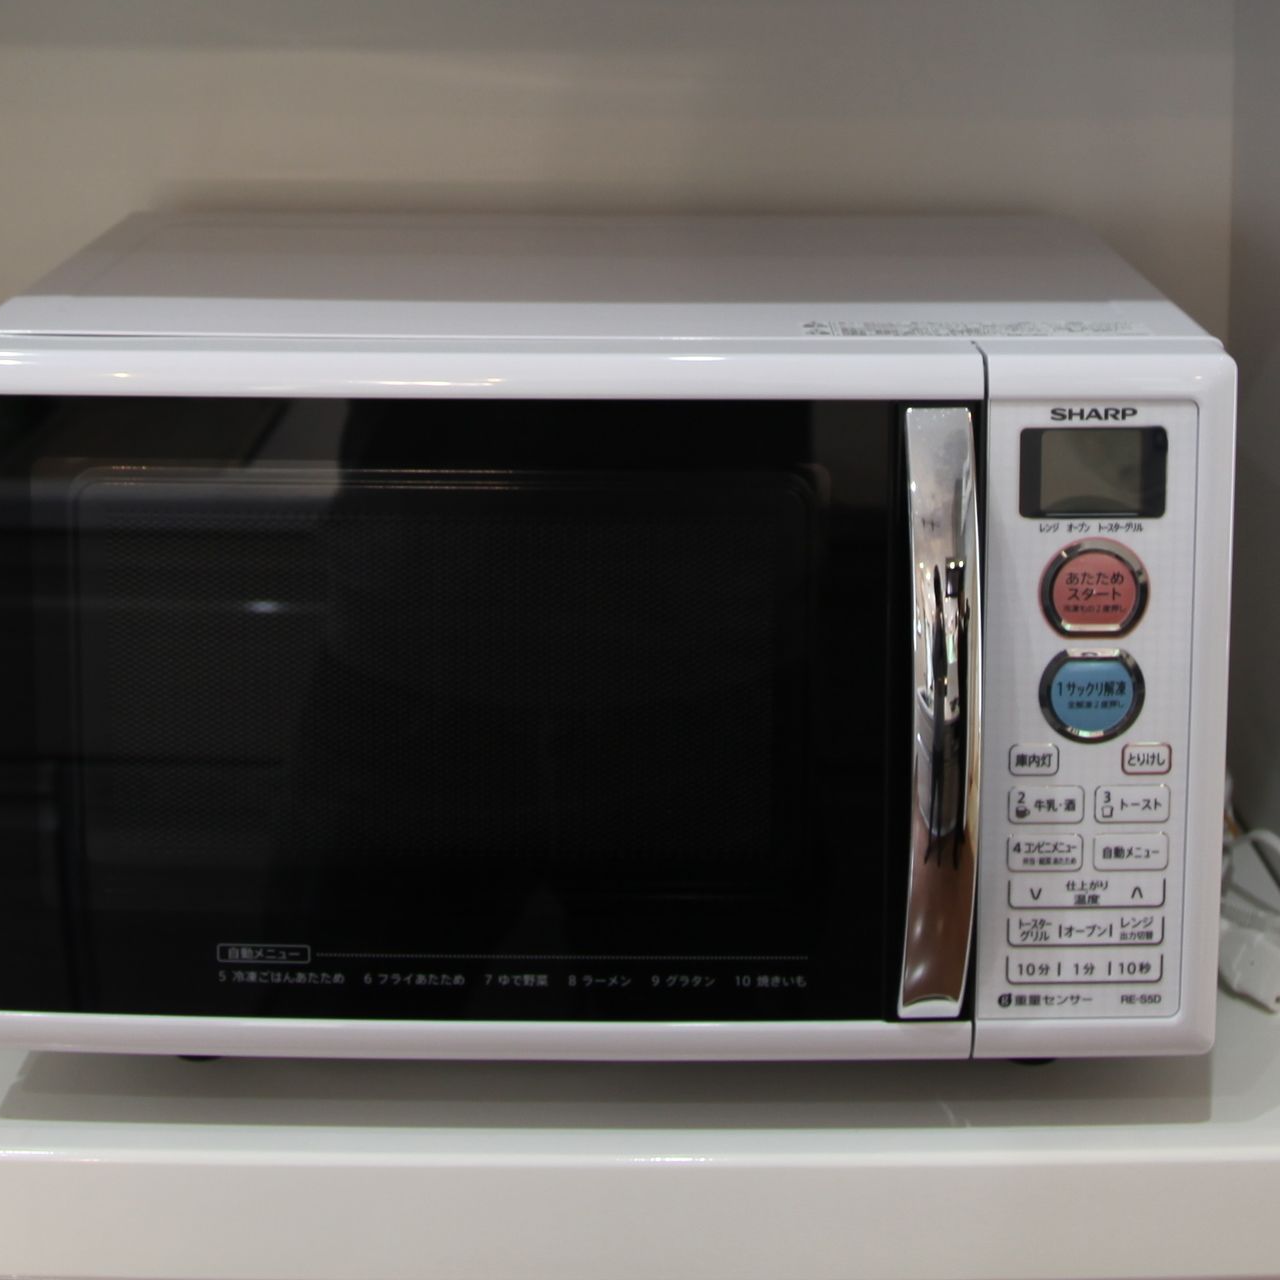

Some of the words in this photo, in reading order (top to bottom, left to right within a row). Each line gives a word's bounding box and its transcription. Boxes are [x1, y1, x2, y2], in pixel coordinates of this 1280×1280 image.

[1050, 407, 1138, 421] SHARP
[1065, 571, 1124, 586] あたため
[1067, 588, 1122, 601] スタート
[1066, 681, 1126, 697] サックリ解凍
[1015, 753, 1053, 768] 庫内灯
[1127, 752, 1165, 767] とりけし
[1017, 791, 1025, 804] 2
[1103, 791, 1111, 803] 3
[1034, 799, 1076, 812] 牛乳・酒
[1120, 798, 1162, 811] トースト
[1102, 847, 1160, 860] 自動メニュー
[1066, 880, 1108, 892] 仕上がり
[1074, 894, 1100, 905] 温度
[1120, 916, 1154, 928] レンジ
[1020, 931, 1050, 942] グリル
[227, 947, 301, 960] 自動メニュー
[1018, 963, 1050, 976] 10分
[1073, 962, 1095, 975] 1分
[1119, 961, 1151, 975] 10秒
[377, 973, 465, 986] フライあたため
[582, 974, 632, 987] ラーメン
[666, 974, 716, 988] グラタン
